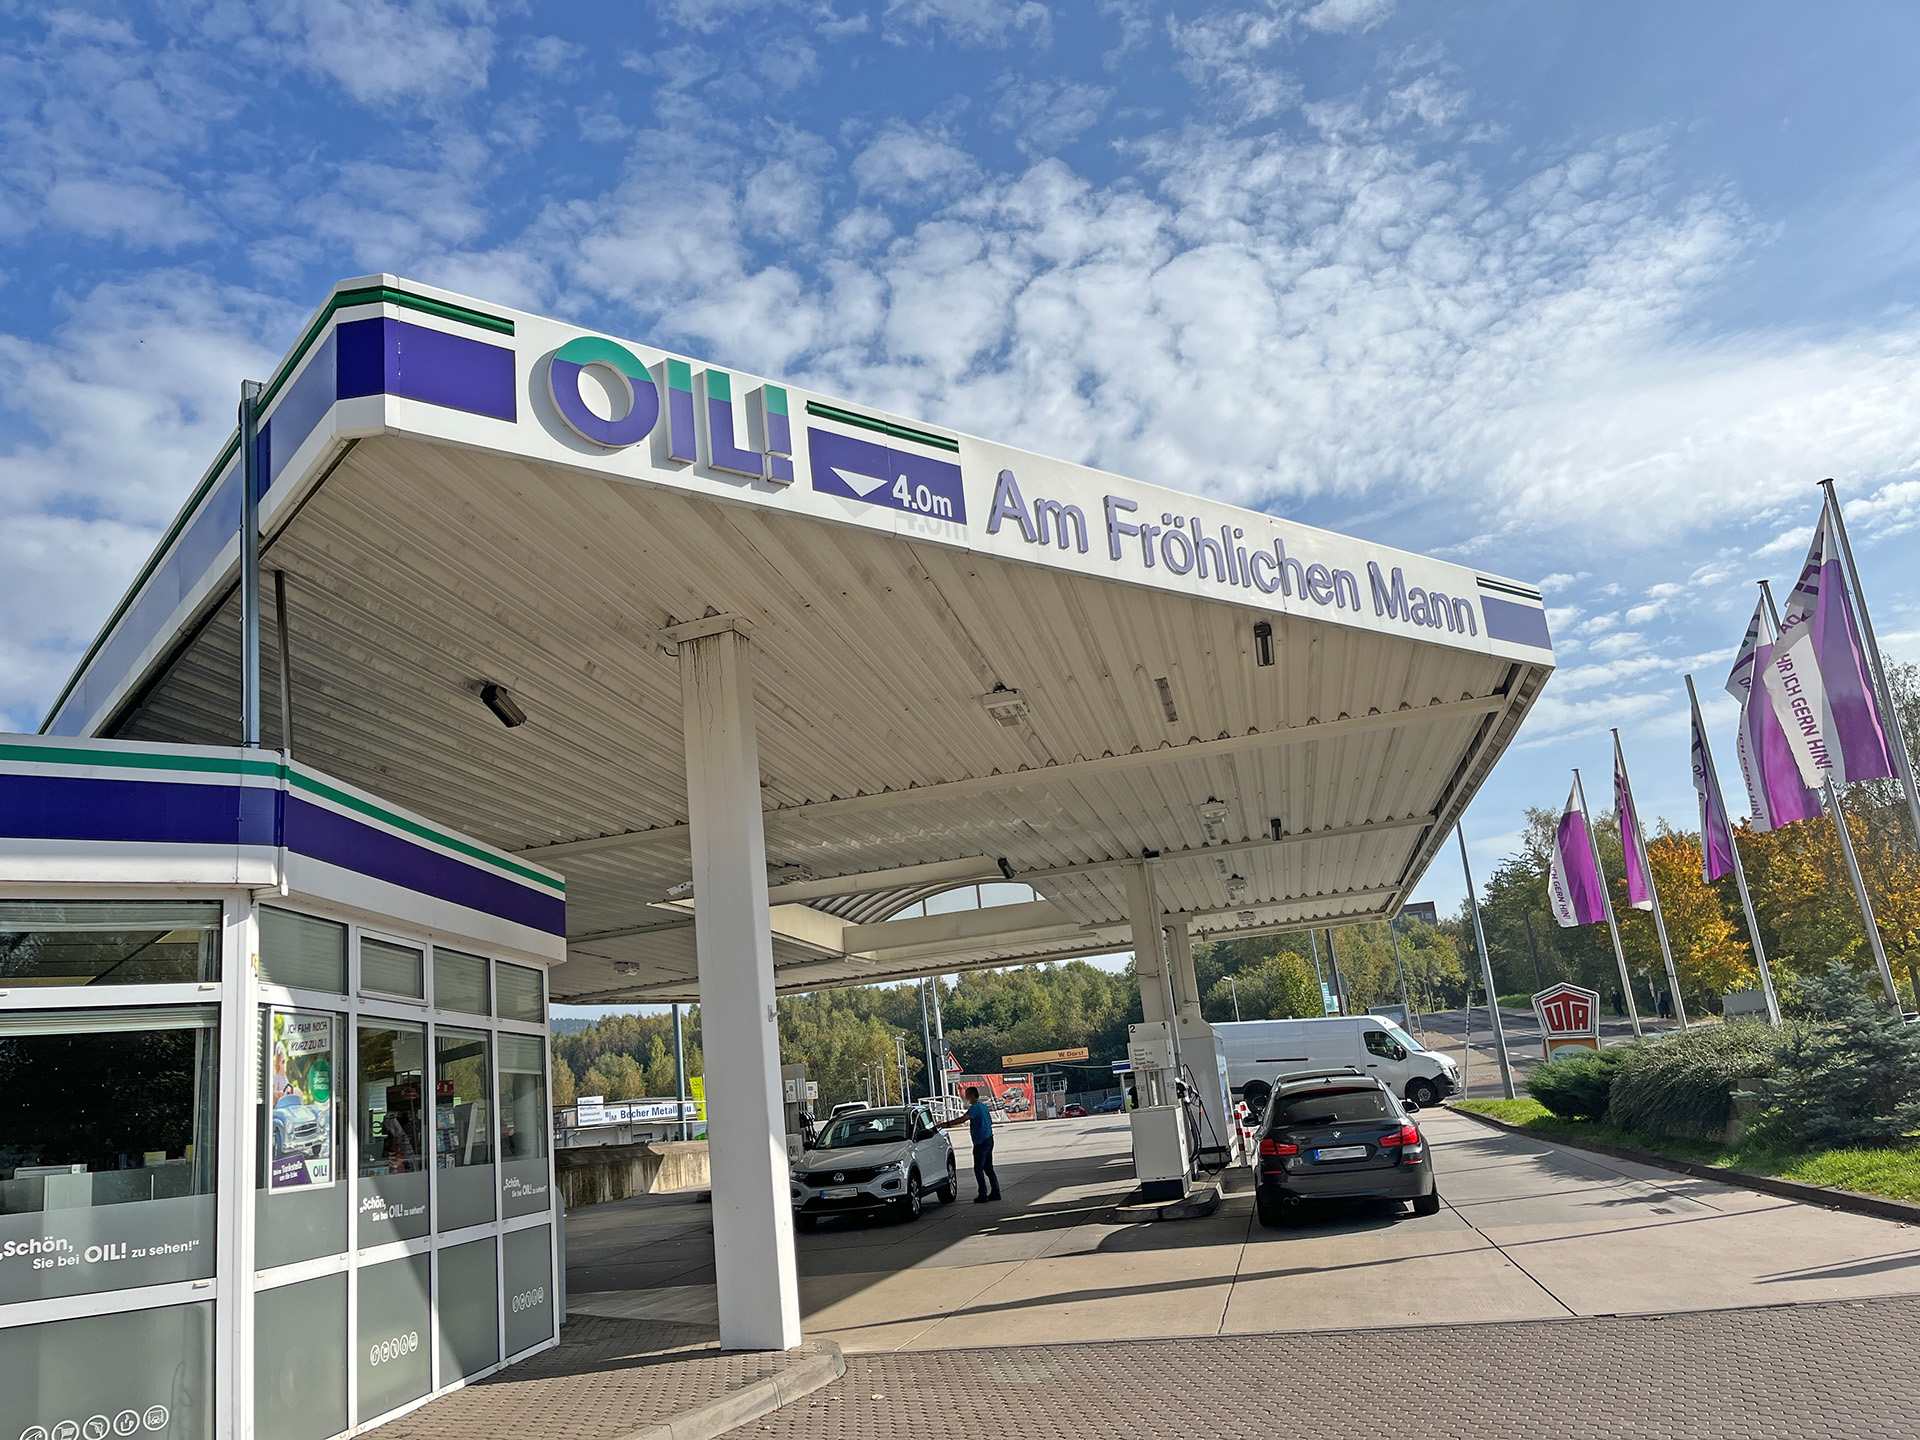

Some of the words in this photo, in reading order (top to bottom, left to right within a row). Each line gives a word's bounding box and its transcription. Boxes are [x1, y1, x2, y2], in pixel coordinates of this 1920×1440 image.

[546, 336, 794, 488] OIL!
[892, 474, 953, 518] 4.0m
[985, 468, 1090, 555] Am
[1103, 494, 1362, 613] Fröhlichen
[1366, 560, 1479, 637] Mann
[1781, 672, 1803, 697] ICH
[1790, 697, 1820, 737] GERN
[1806, 738, 1834, 770] HIN!
[1553, 880, 1566, 903] GERN
[1542, 992, 1589, 1031] UTA
[297, 1022, 312, 1033] FAHR
[312, 1021, 328, 1032] NOCH
[1129, 1024, 1136, 1034] 2
[1161, 1021, 1166, 1030] 1
[620, 1108, 650, 1120] Becher
[313, 1164, 328, 1178] OIL!
[388, 1203, 404, 1219] OIL!
[32, 1256, 55, 1270] Sie
[57, 1253, 81, 1268] bei
[83, 1242, 128, 1264] OIL!
[131, 1247, 147, 1259] zu
